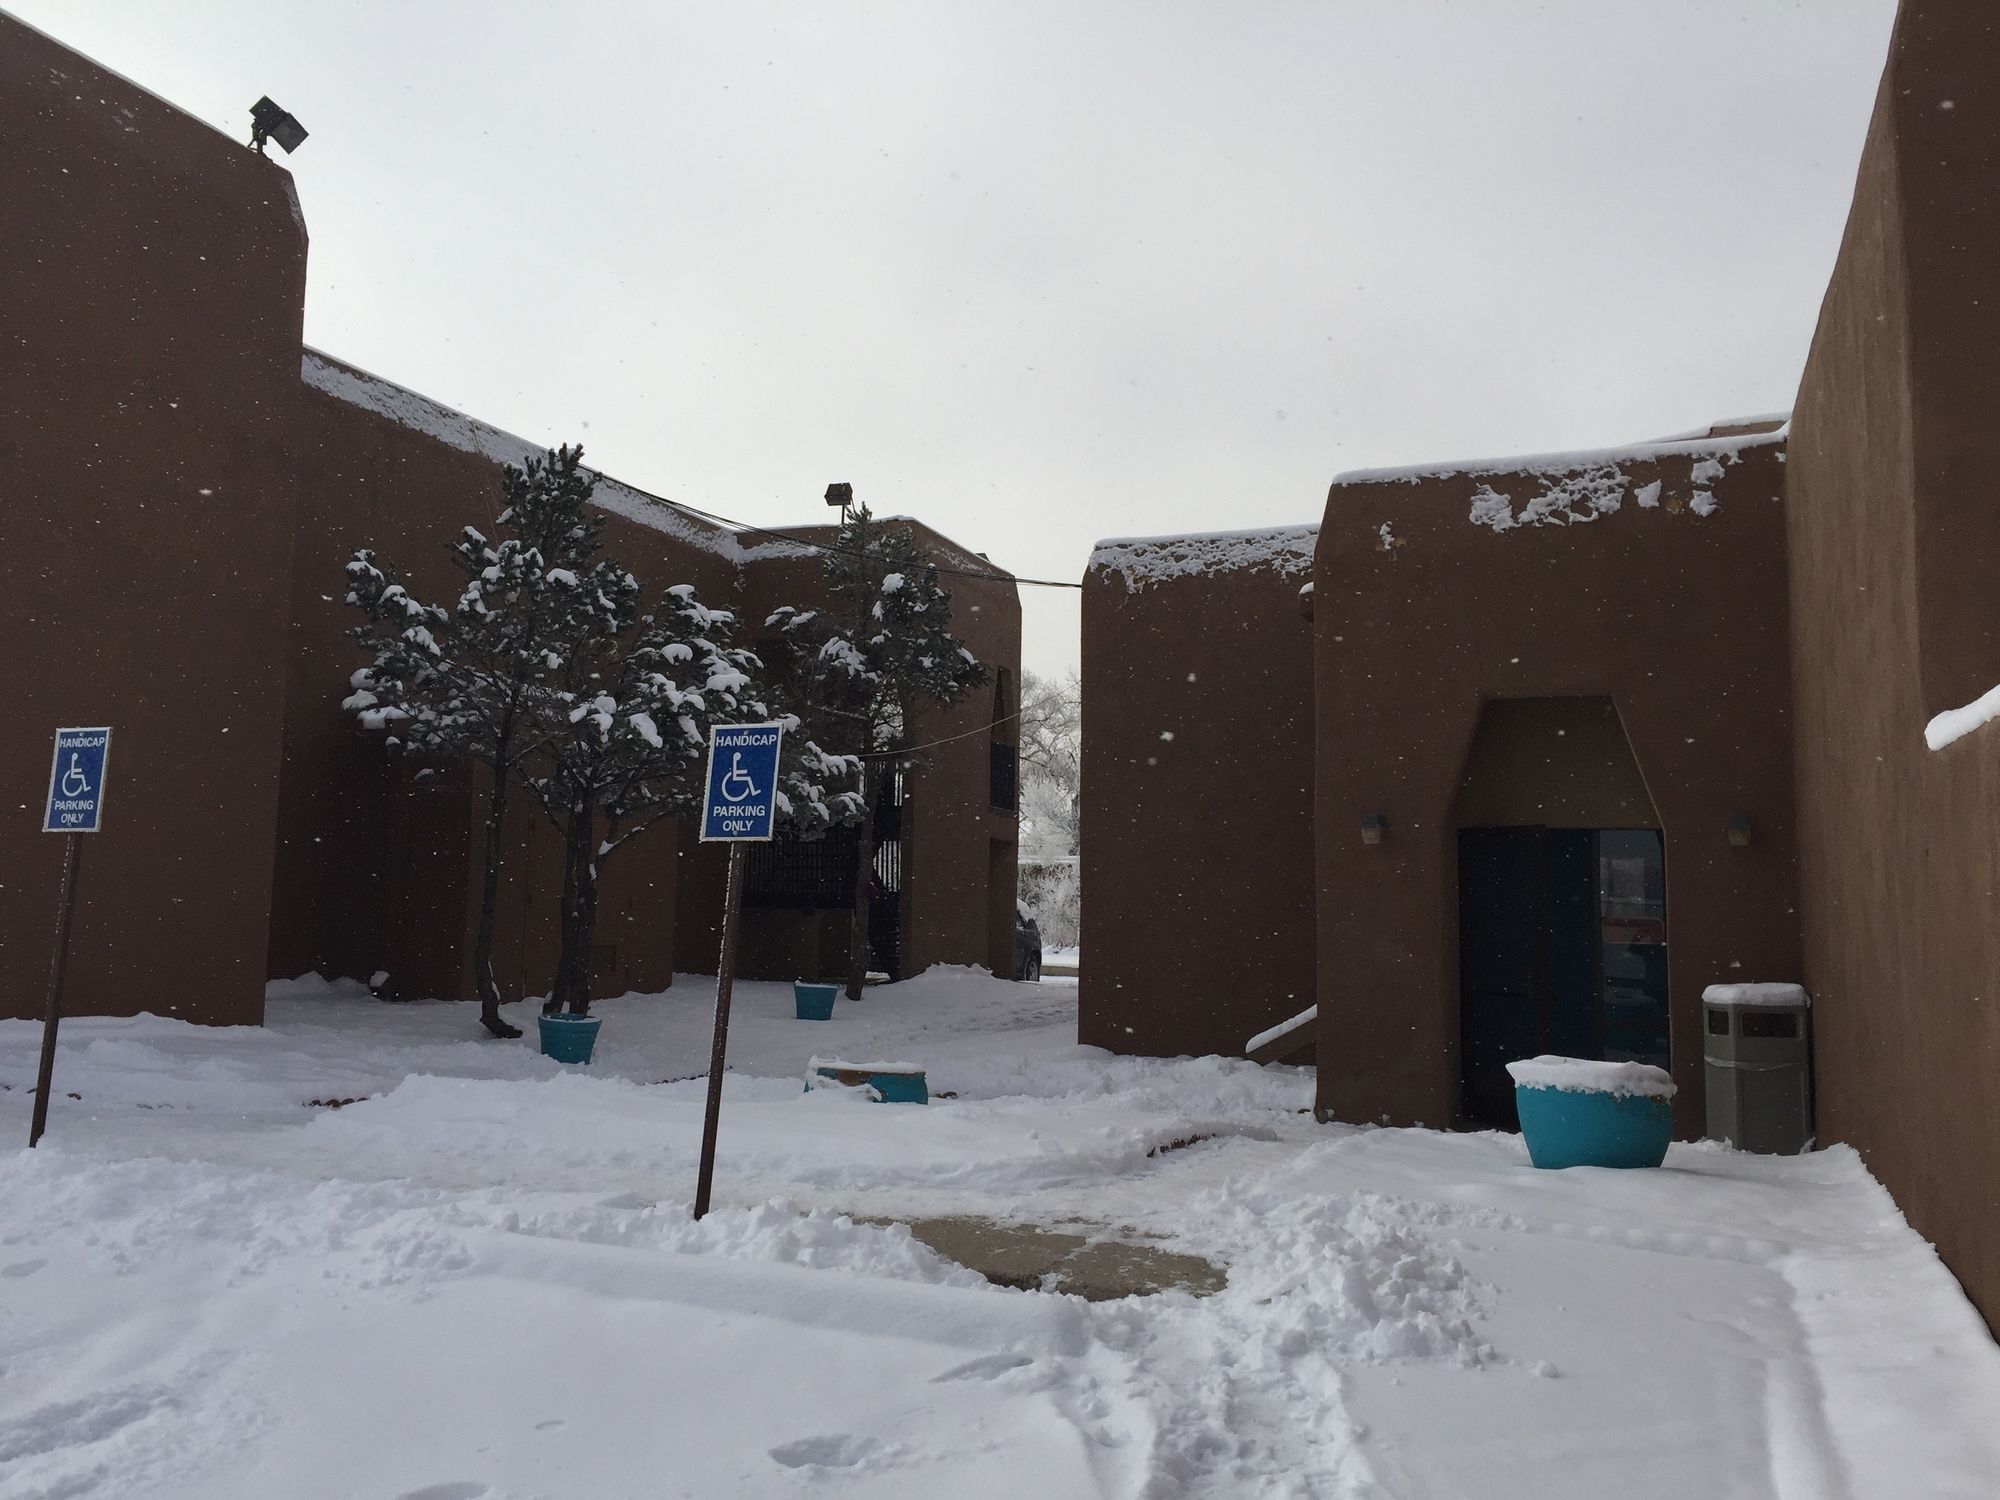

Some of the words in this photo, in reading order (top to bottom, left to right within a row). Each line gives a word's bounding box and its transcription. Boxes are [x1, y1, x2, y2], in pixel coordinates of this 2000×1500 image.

[59, 737, 105, 748] HANDICAP
[715, 734, 777, 747] HANDICAP
[54, 800, 94, 811] PARKING
[713, 805, 765, 817] PARKING
[60, 813, 84, 823] ONLY
[722, 820, 754, 831] ONLY
